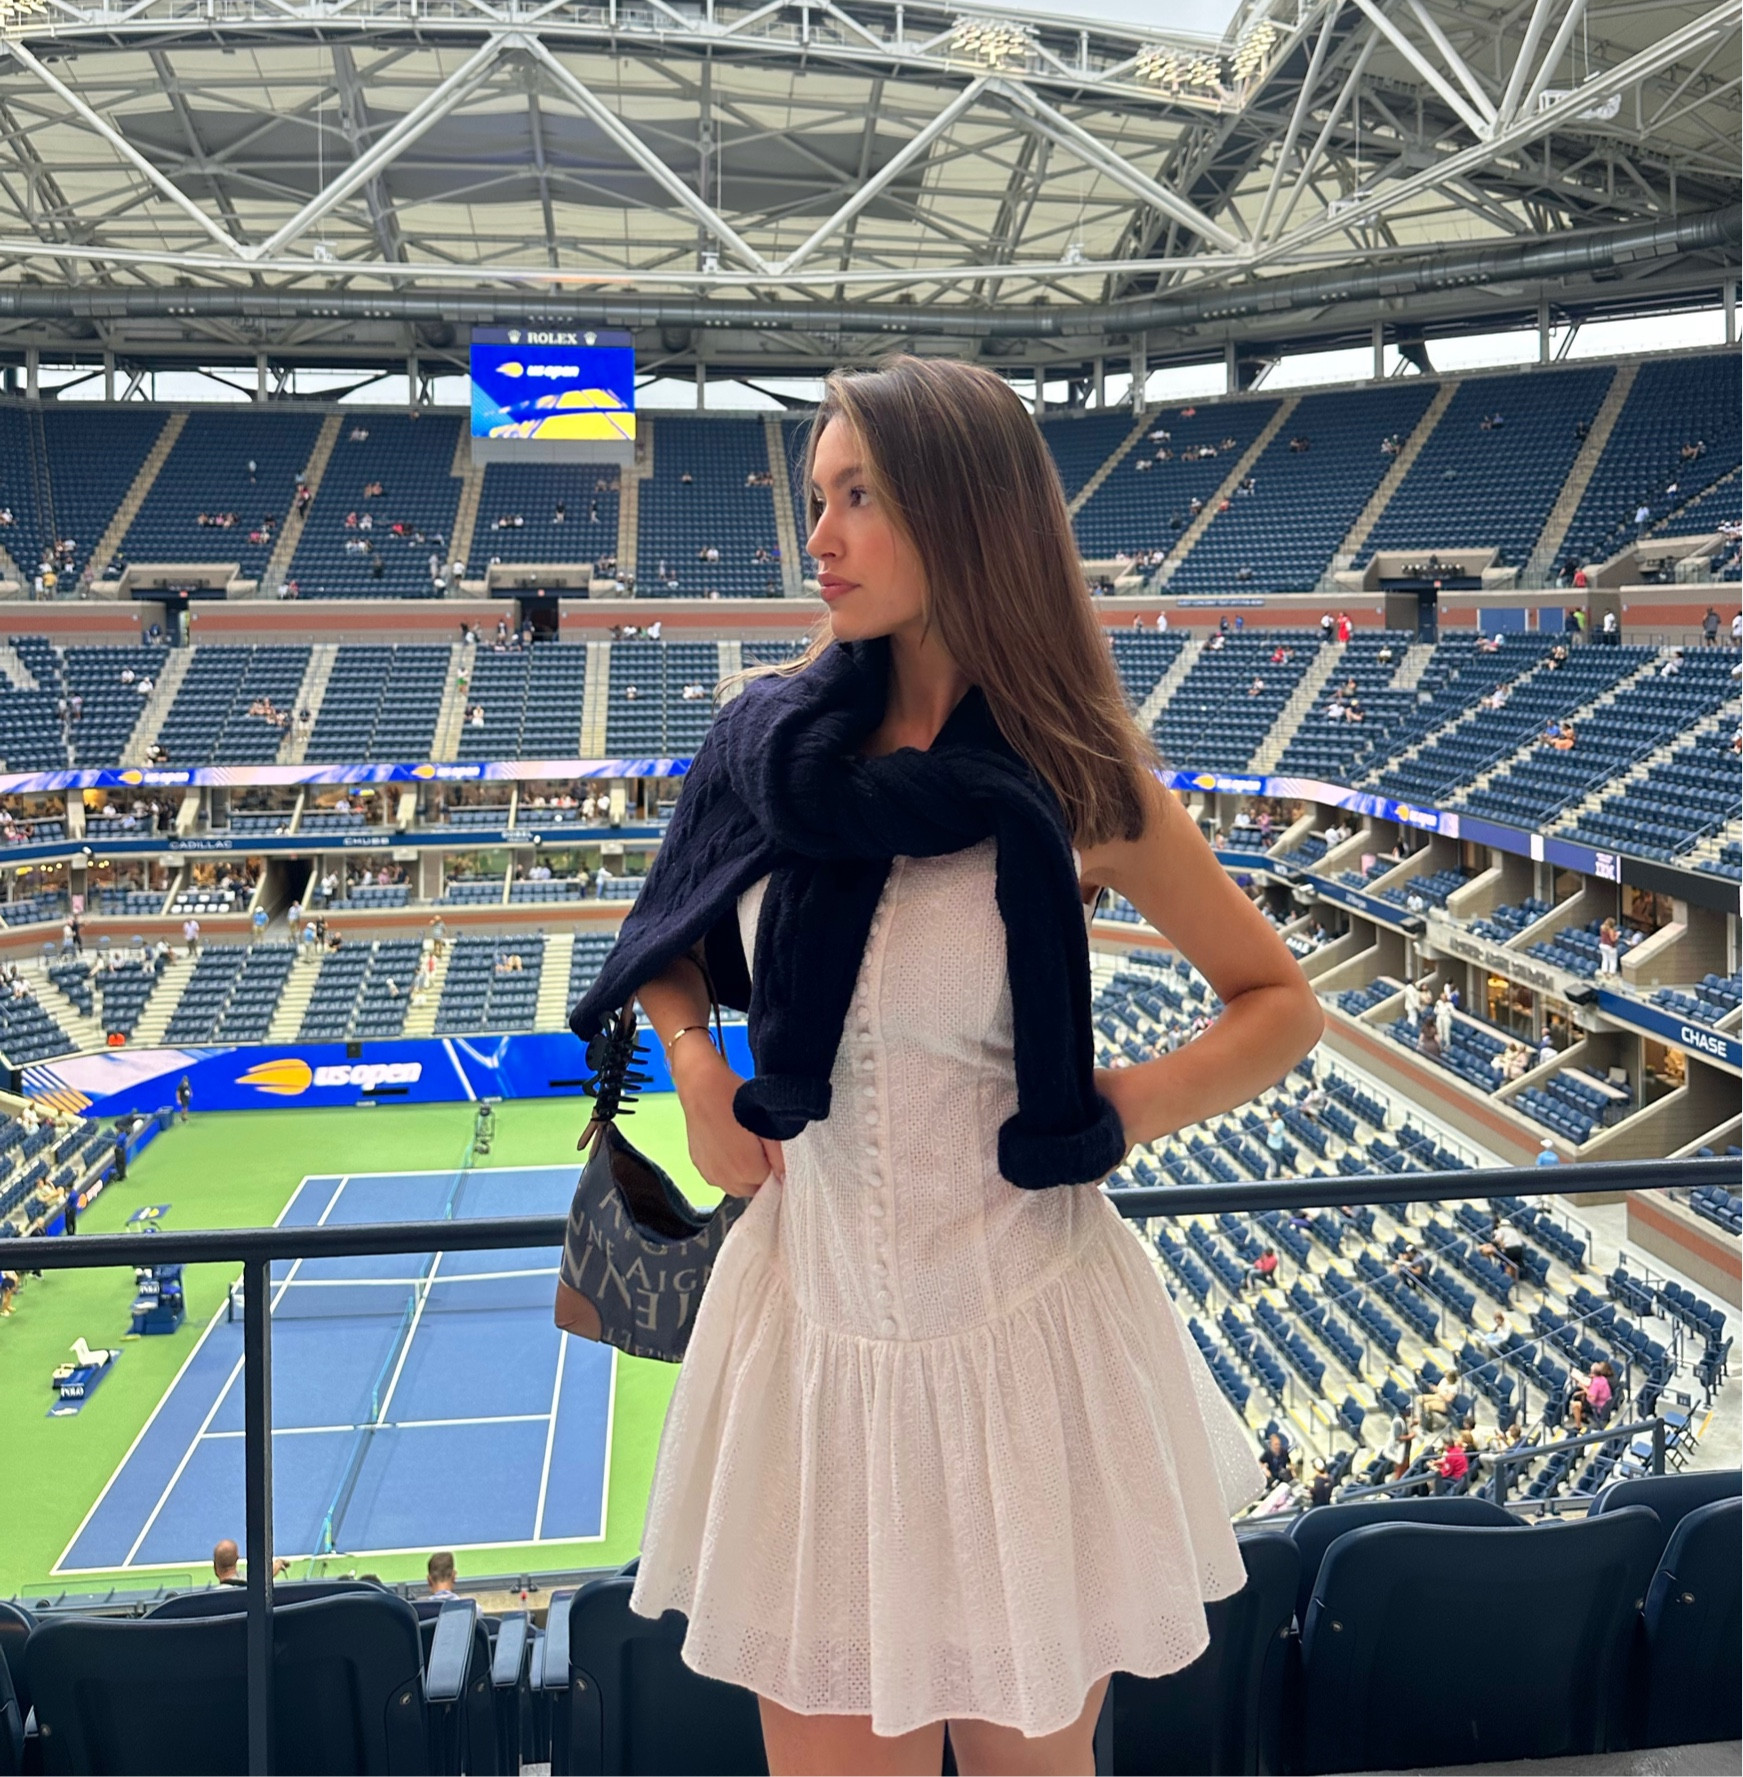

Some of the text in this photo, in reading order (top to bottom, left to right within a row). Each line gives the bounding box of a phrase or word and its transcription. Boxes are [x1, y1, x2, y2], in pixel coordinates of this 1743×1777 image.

[527, 332, 578, 345] ROLEX
[168, 840, 233, 850] CADILLAC
[342, 836, 390, 846] CHUBB
[1681, 1026, 1727, 1058] CHASE
